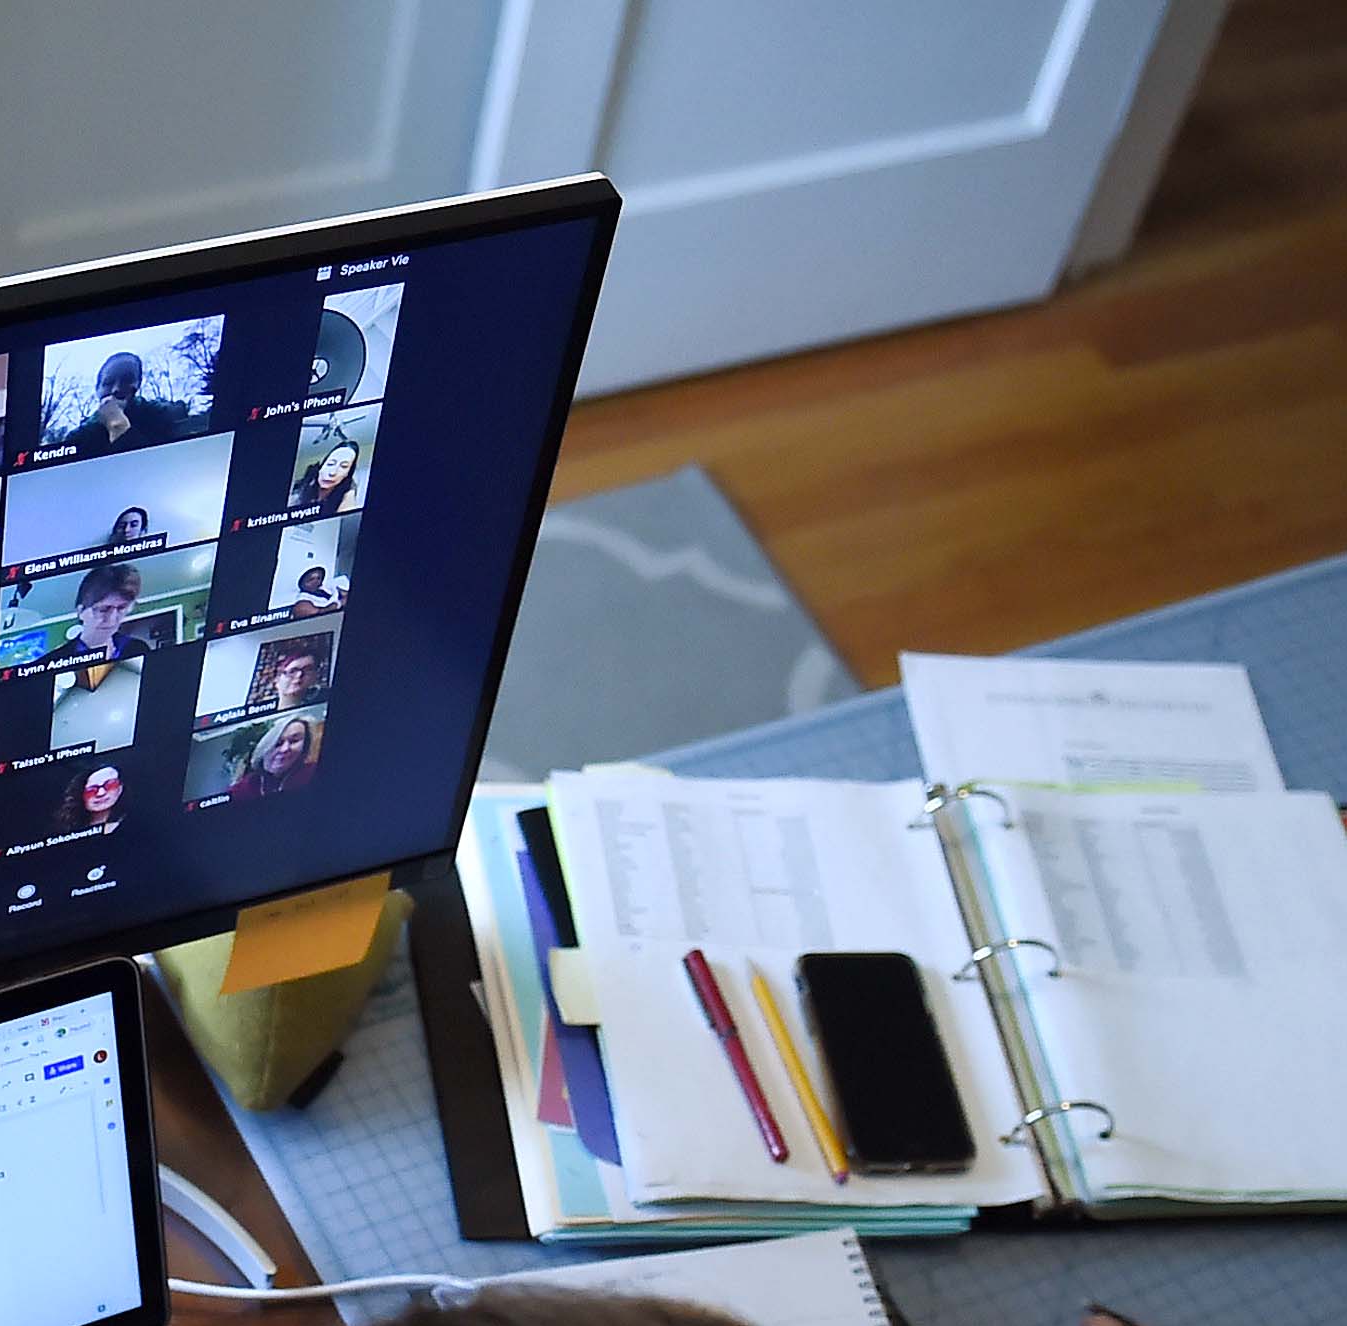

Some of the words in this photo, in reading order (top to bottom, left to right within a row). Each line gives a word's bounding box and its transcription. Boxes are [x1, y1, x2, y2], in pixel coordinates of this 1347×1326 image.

[339, 259, 389, 276] Speaker
[264, 402, 301, 418] John's
[303, 393, 342, 412] iPhone
[33, 445, 77, 462] Kendra
[247, 510, 289, 529] kristina
[291, 505, 321, 522] wyatt
[24, 558, 56, 575] Elena
[58, 537, 163, 569] Williams-Moreiras
[230, 619, 249, 630] Eva
[17, 662, 45, 678] Lynn
[47, 650, 104, 672] Adelmann
[11, 753, 54, 771] Taisto's
[56, 745, 93, 760] iPhone
[8, 898, 43, 914] Record
